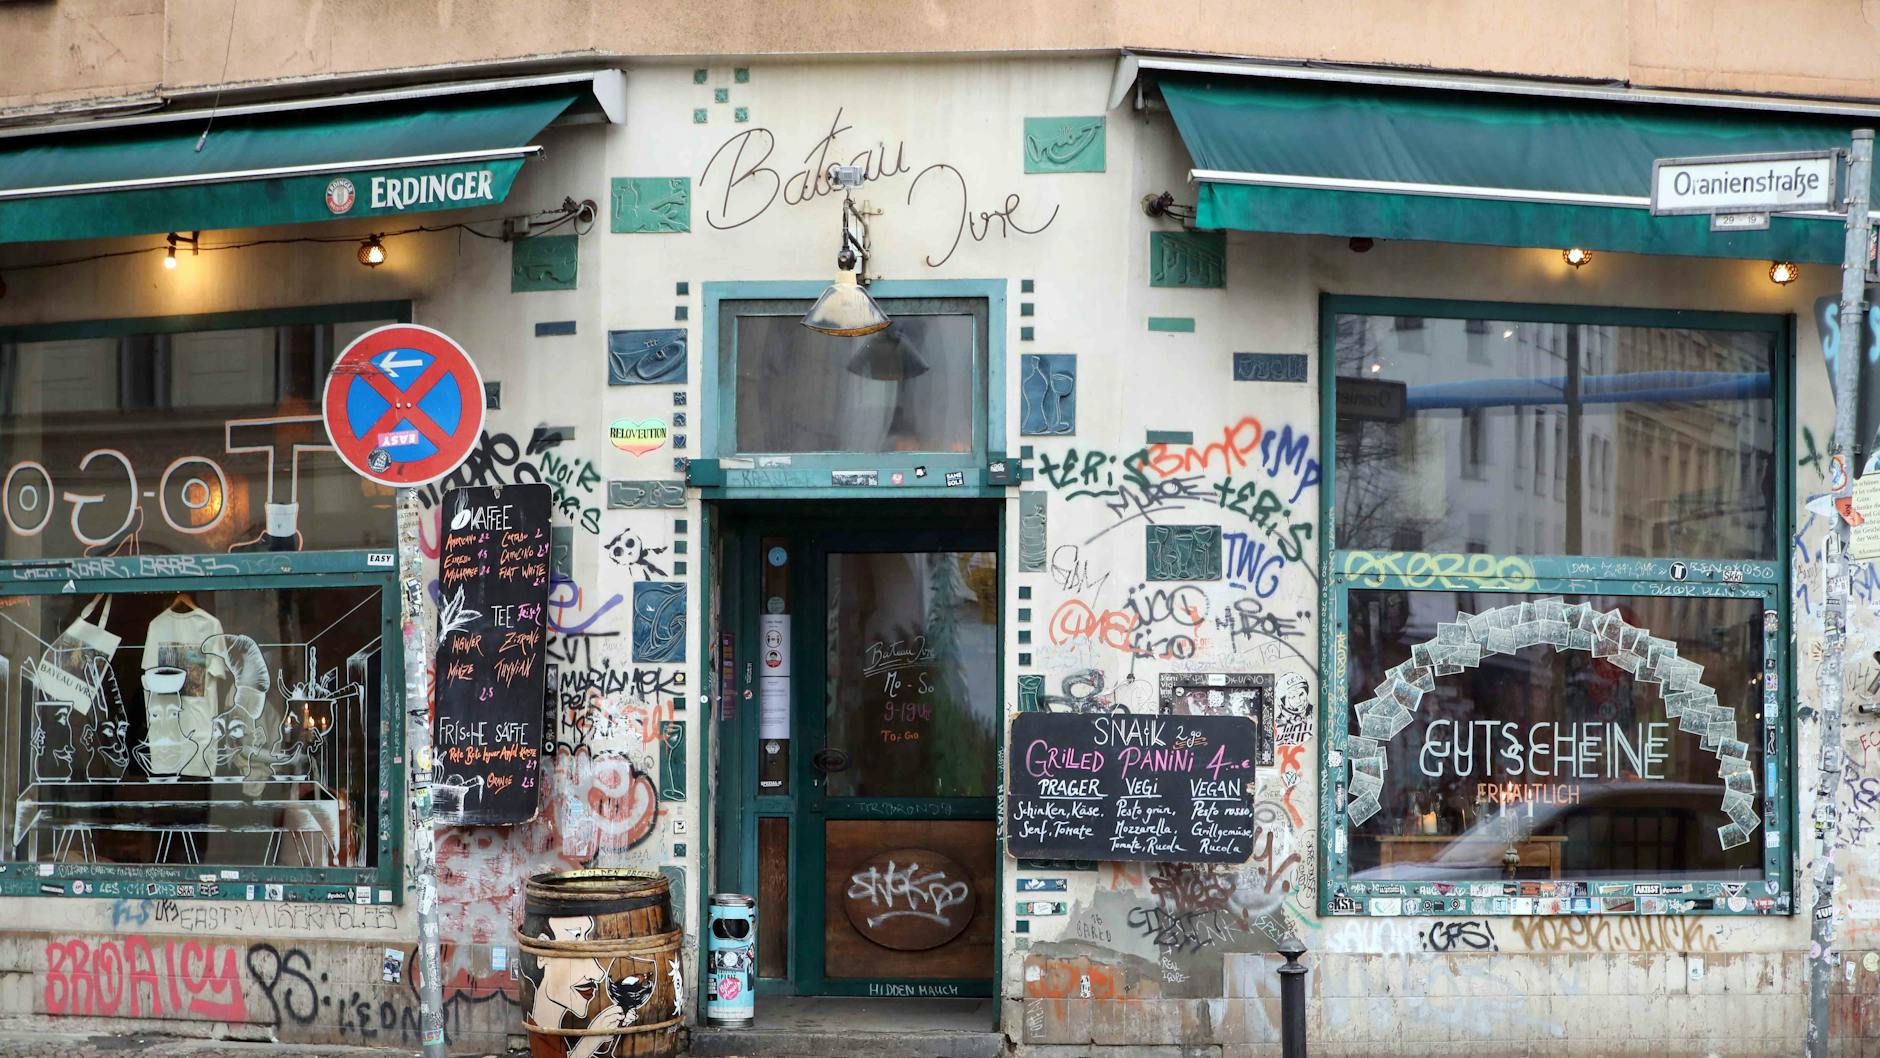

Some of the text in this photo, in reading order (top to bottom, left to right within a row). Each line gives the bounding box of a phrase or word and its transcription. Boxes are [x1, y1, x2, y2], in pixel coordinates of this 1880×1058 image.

[370, 170, 494, 209] ERDINGER
[1673, 165, 1819, 198] Oranienstraße
[1723, 216, 1735, 225] 29
[382, 435, 416, 447] EASY
[609, 427, 667, 439] RELOVEUTION
[470, 505, 513, 530] KAFFEE
[369, 554, 392, 562] EASY
[491, 605, 514, 628] TEE
[495, 721, 529, 745] SÄFTE
[1176, 725, 1188, 741] 2
[1419, 720, 1669, 780] GUTSCHEINE
[1038, 778, 1108, 797] PRAGER
[1190, 778, 1241, 797] VEGAN
[1476, 783, 1580, 804] ERHÄLTLICH
[1116, 799, 1143, 819] Pesto
[1190, 800, 1219, 822] Pesto
[1146, 837, 1187, 853] Rucola
[1199, 838, 1242, 854] Rucola
[869, 983, 915, 996] HIDDEN
